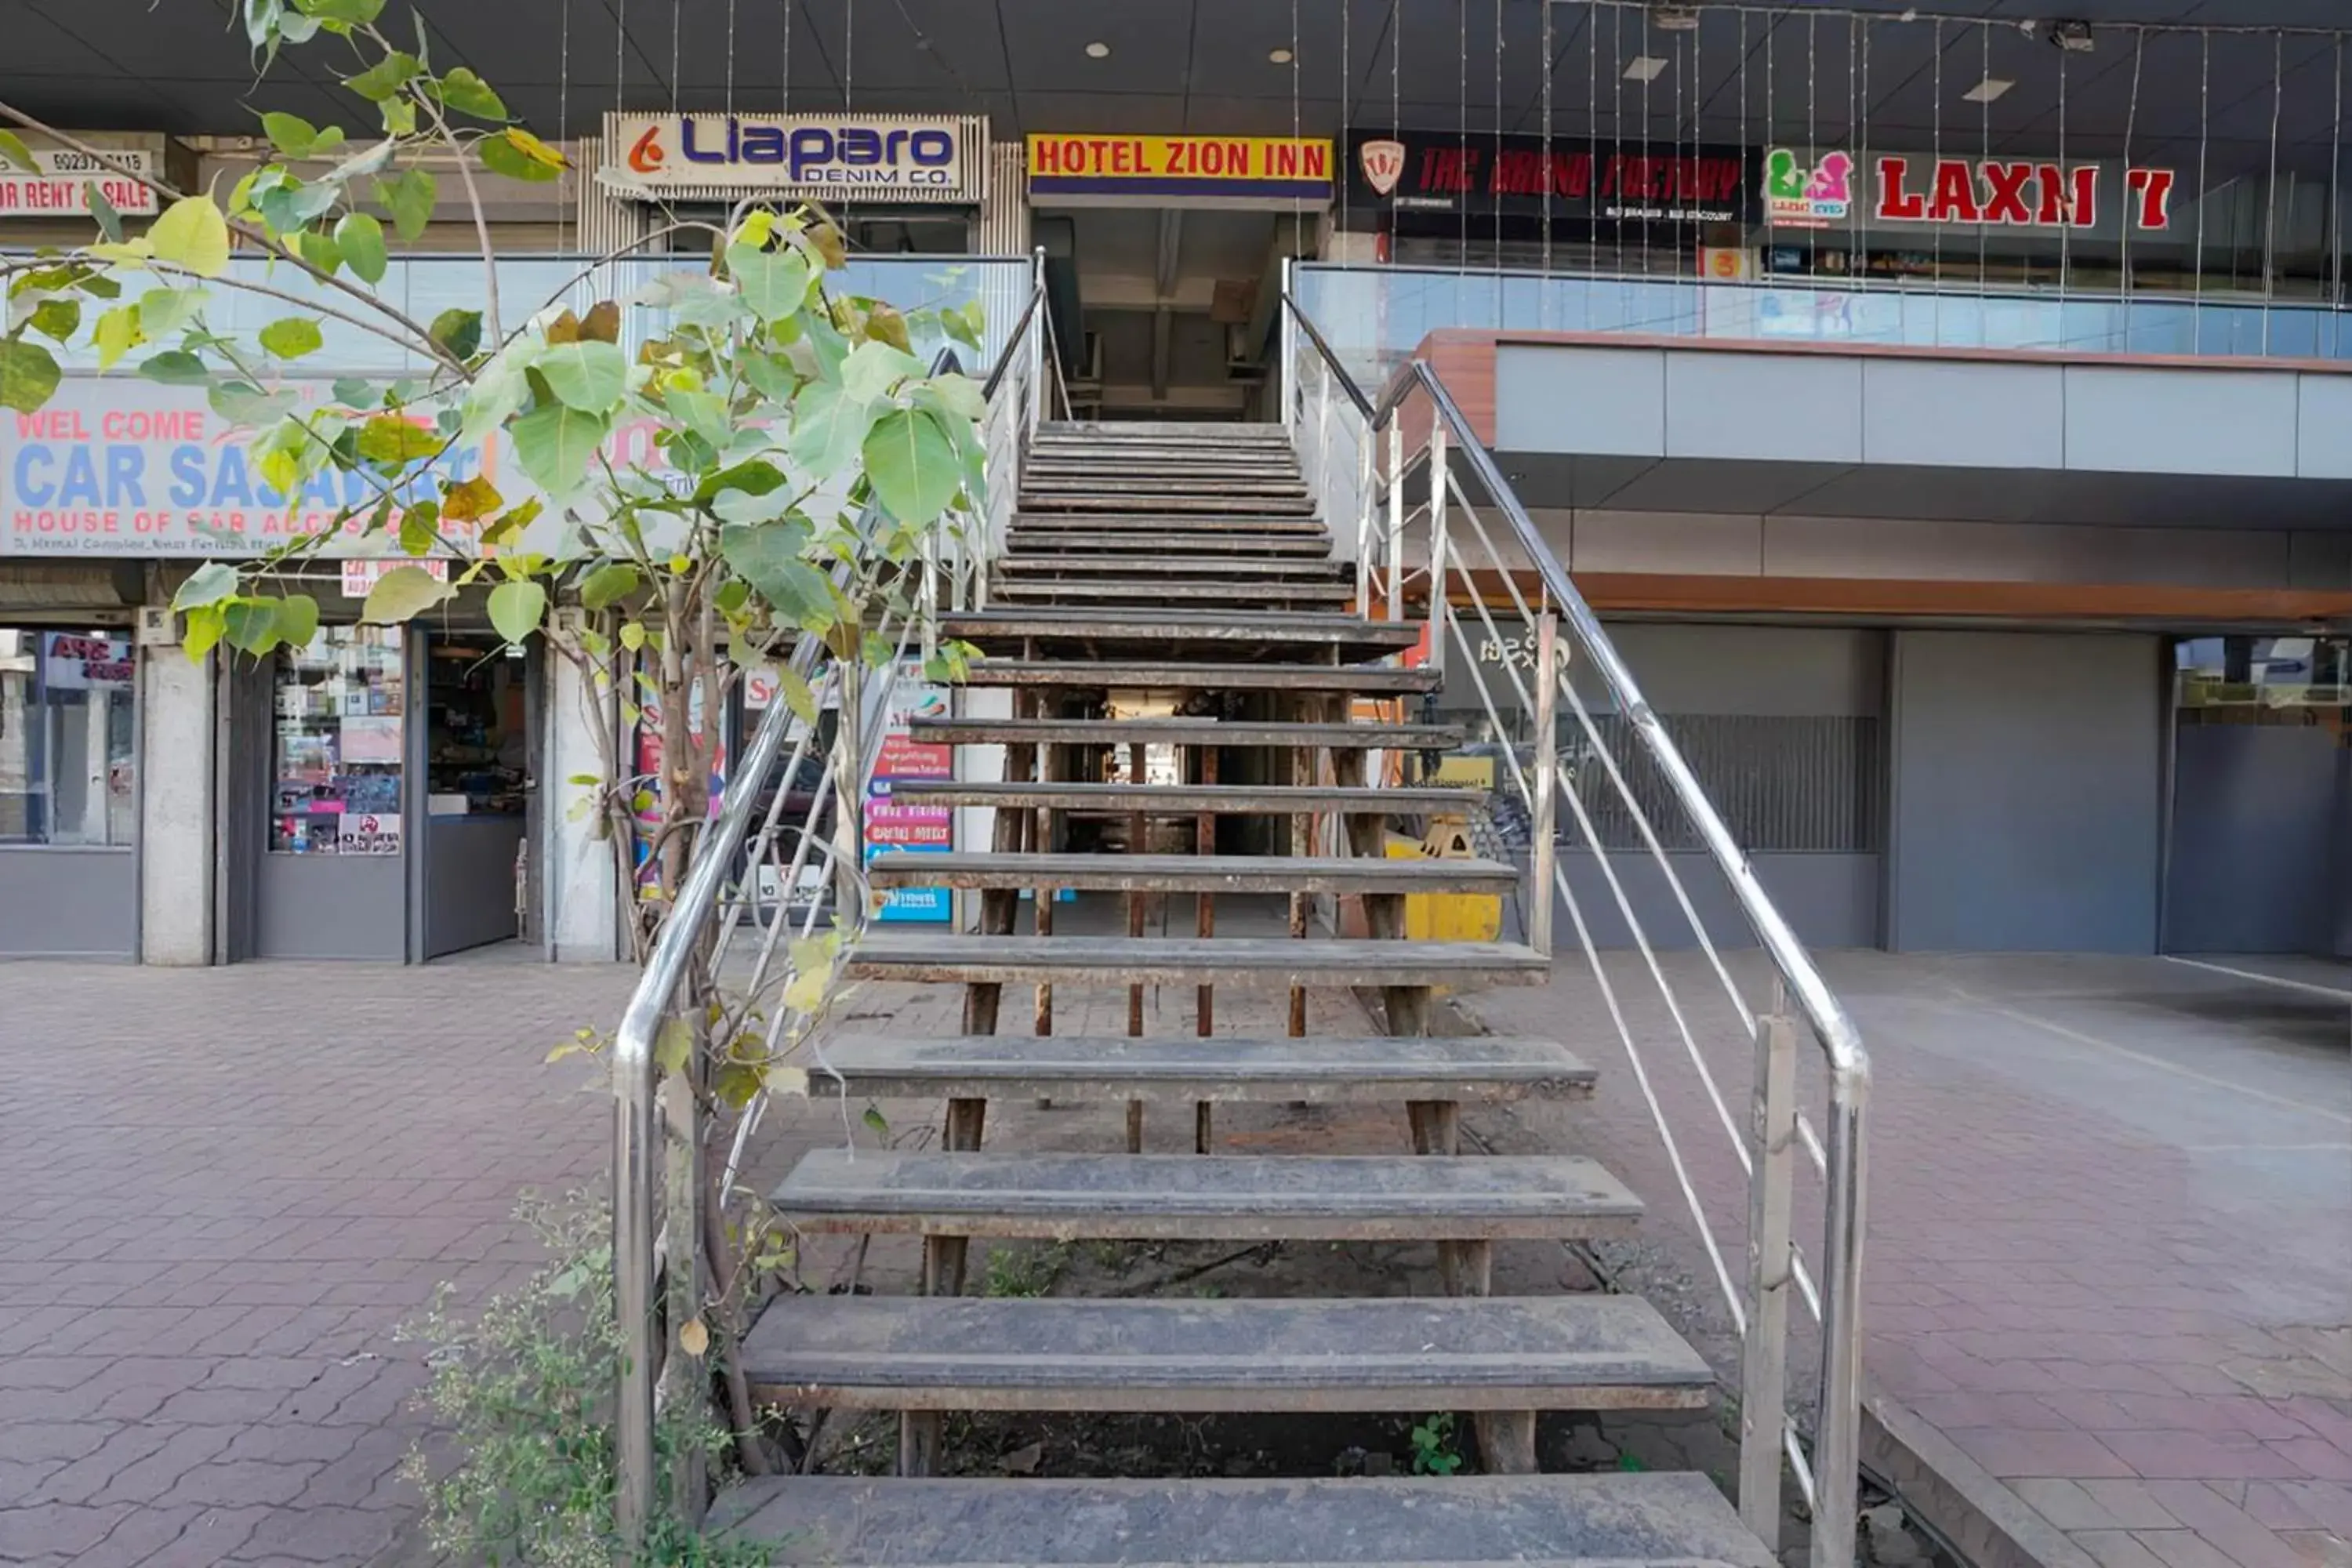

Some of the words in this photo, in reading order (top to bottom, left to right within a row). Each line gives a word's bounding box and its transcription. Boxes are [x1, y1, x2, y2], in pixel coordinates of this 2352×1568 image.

[1036, 140, 1152, 173] HOTEL
[1166, 143, 1249, 176] ZION
[1265, 144, 1325, 176] INN
[1419, 147, 1479, 191] THE
[805, 169, 899, 183] DENIM
[25, 182, 74, 209] RENT
[103, 181, 149, 209] SALE
[16, 411, 92, 439] WEL
[103, 411, 204, 440] COME
[14, 443, 147, 508] CAR
[13, 512, 119, 533] HOUSE
[134, 512, 172, 533] OF
